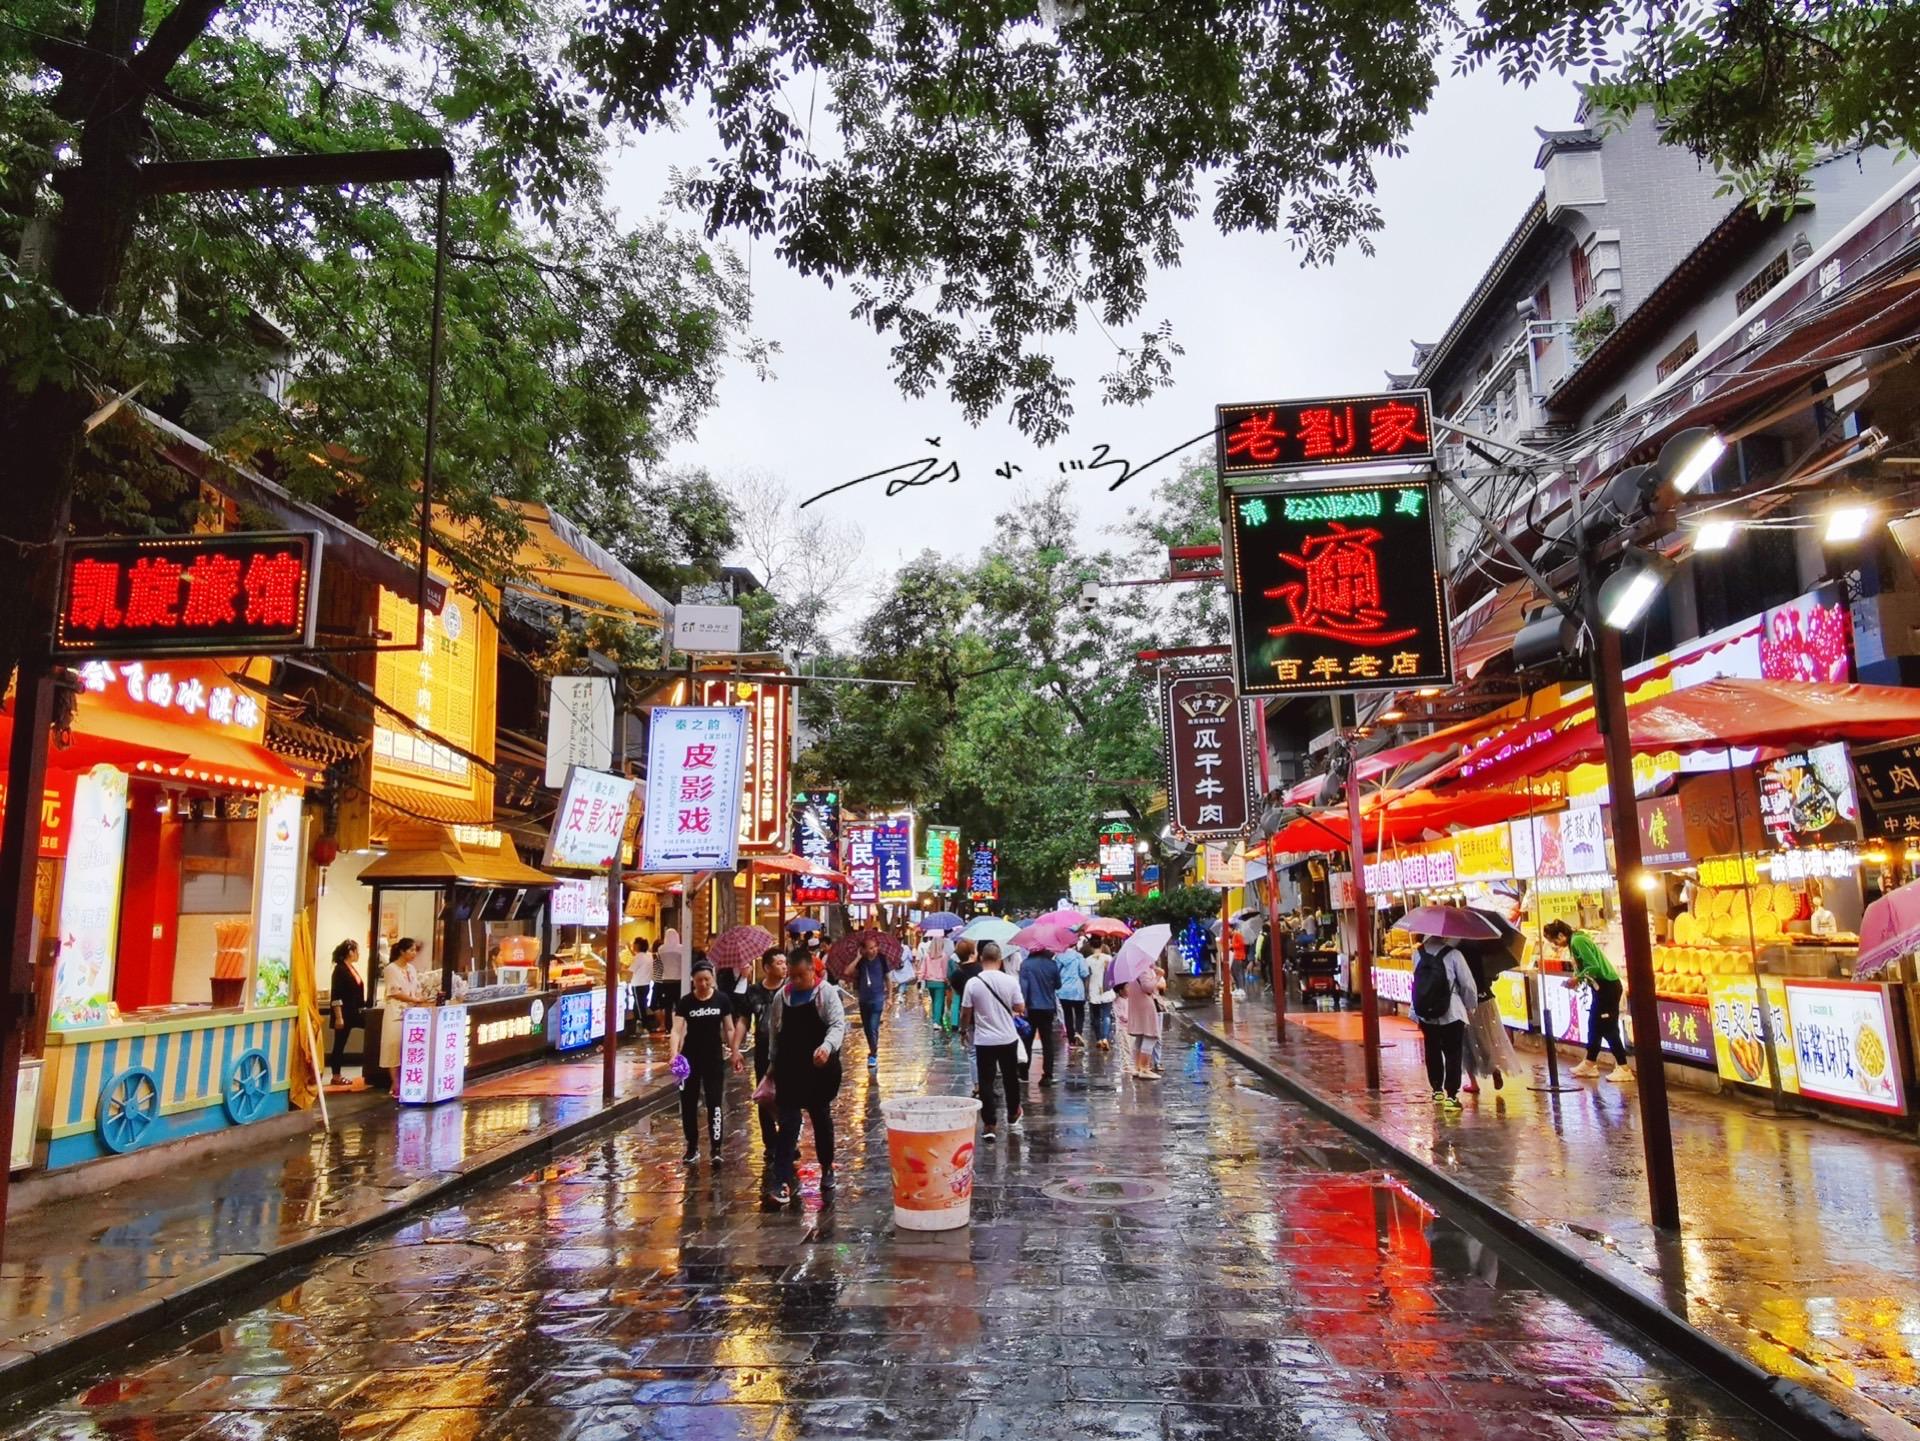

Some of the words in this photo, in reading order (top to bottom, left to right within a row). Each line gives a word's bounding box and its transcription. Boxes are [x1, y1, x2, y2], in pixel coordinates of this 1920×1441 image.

[1227, 402, 1429, 460] 老劉家
[1270, 650, 1420, 681] 百年老店
[678, 743, 717, 835] 皮影戏
[1194, 729, 1224, 825] 风干牛肉
[566, 795, 625, 837] 皮影戏
[689, 1007, 721, 1017] adidas
[406, 1027, 425, 1084] 皮影戏
[443, 1032, 457, 1090] 皮影戏
[714, 1106, 722, 1141] adidas
